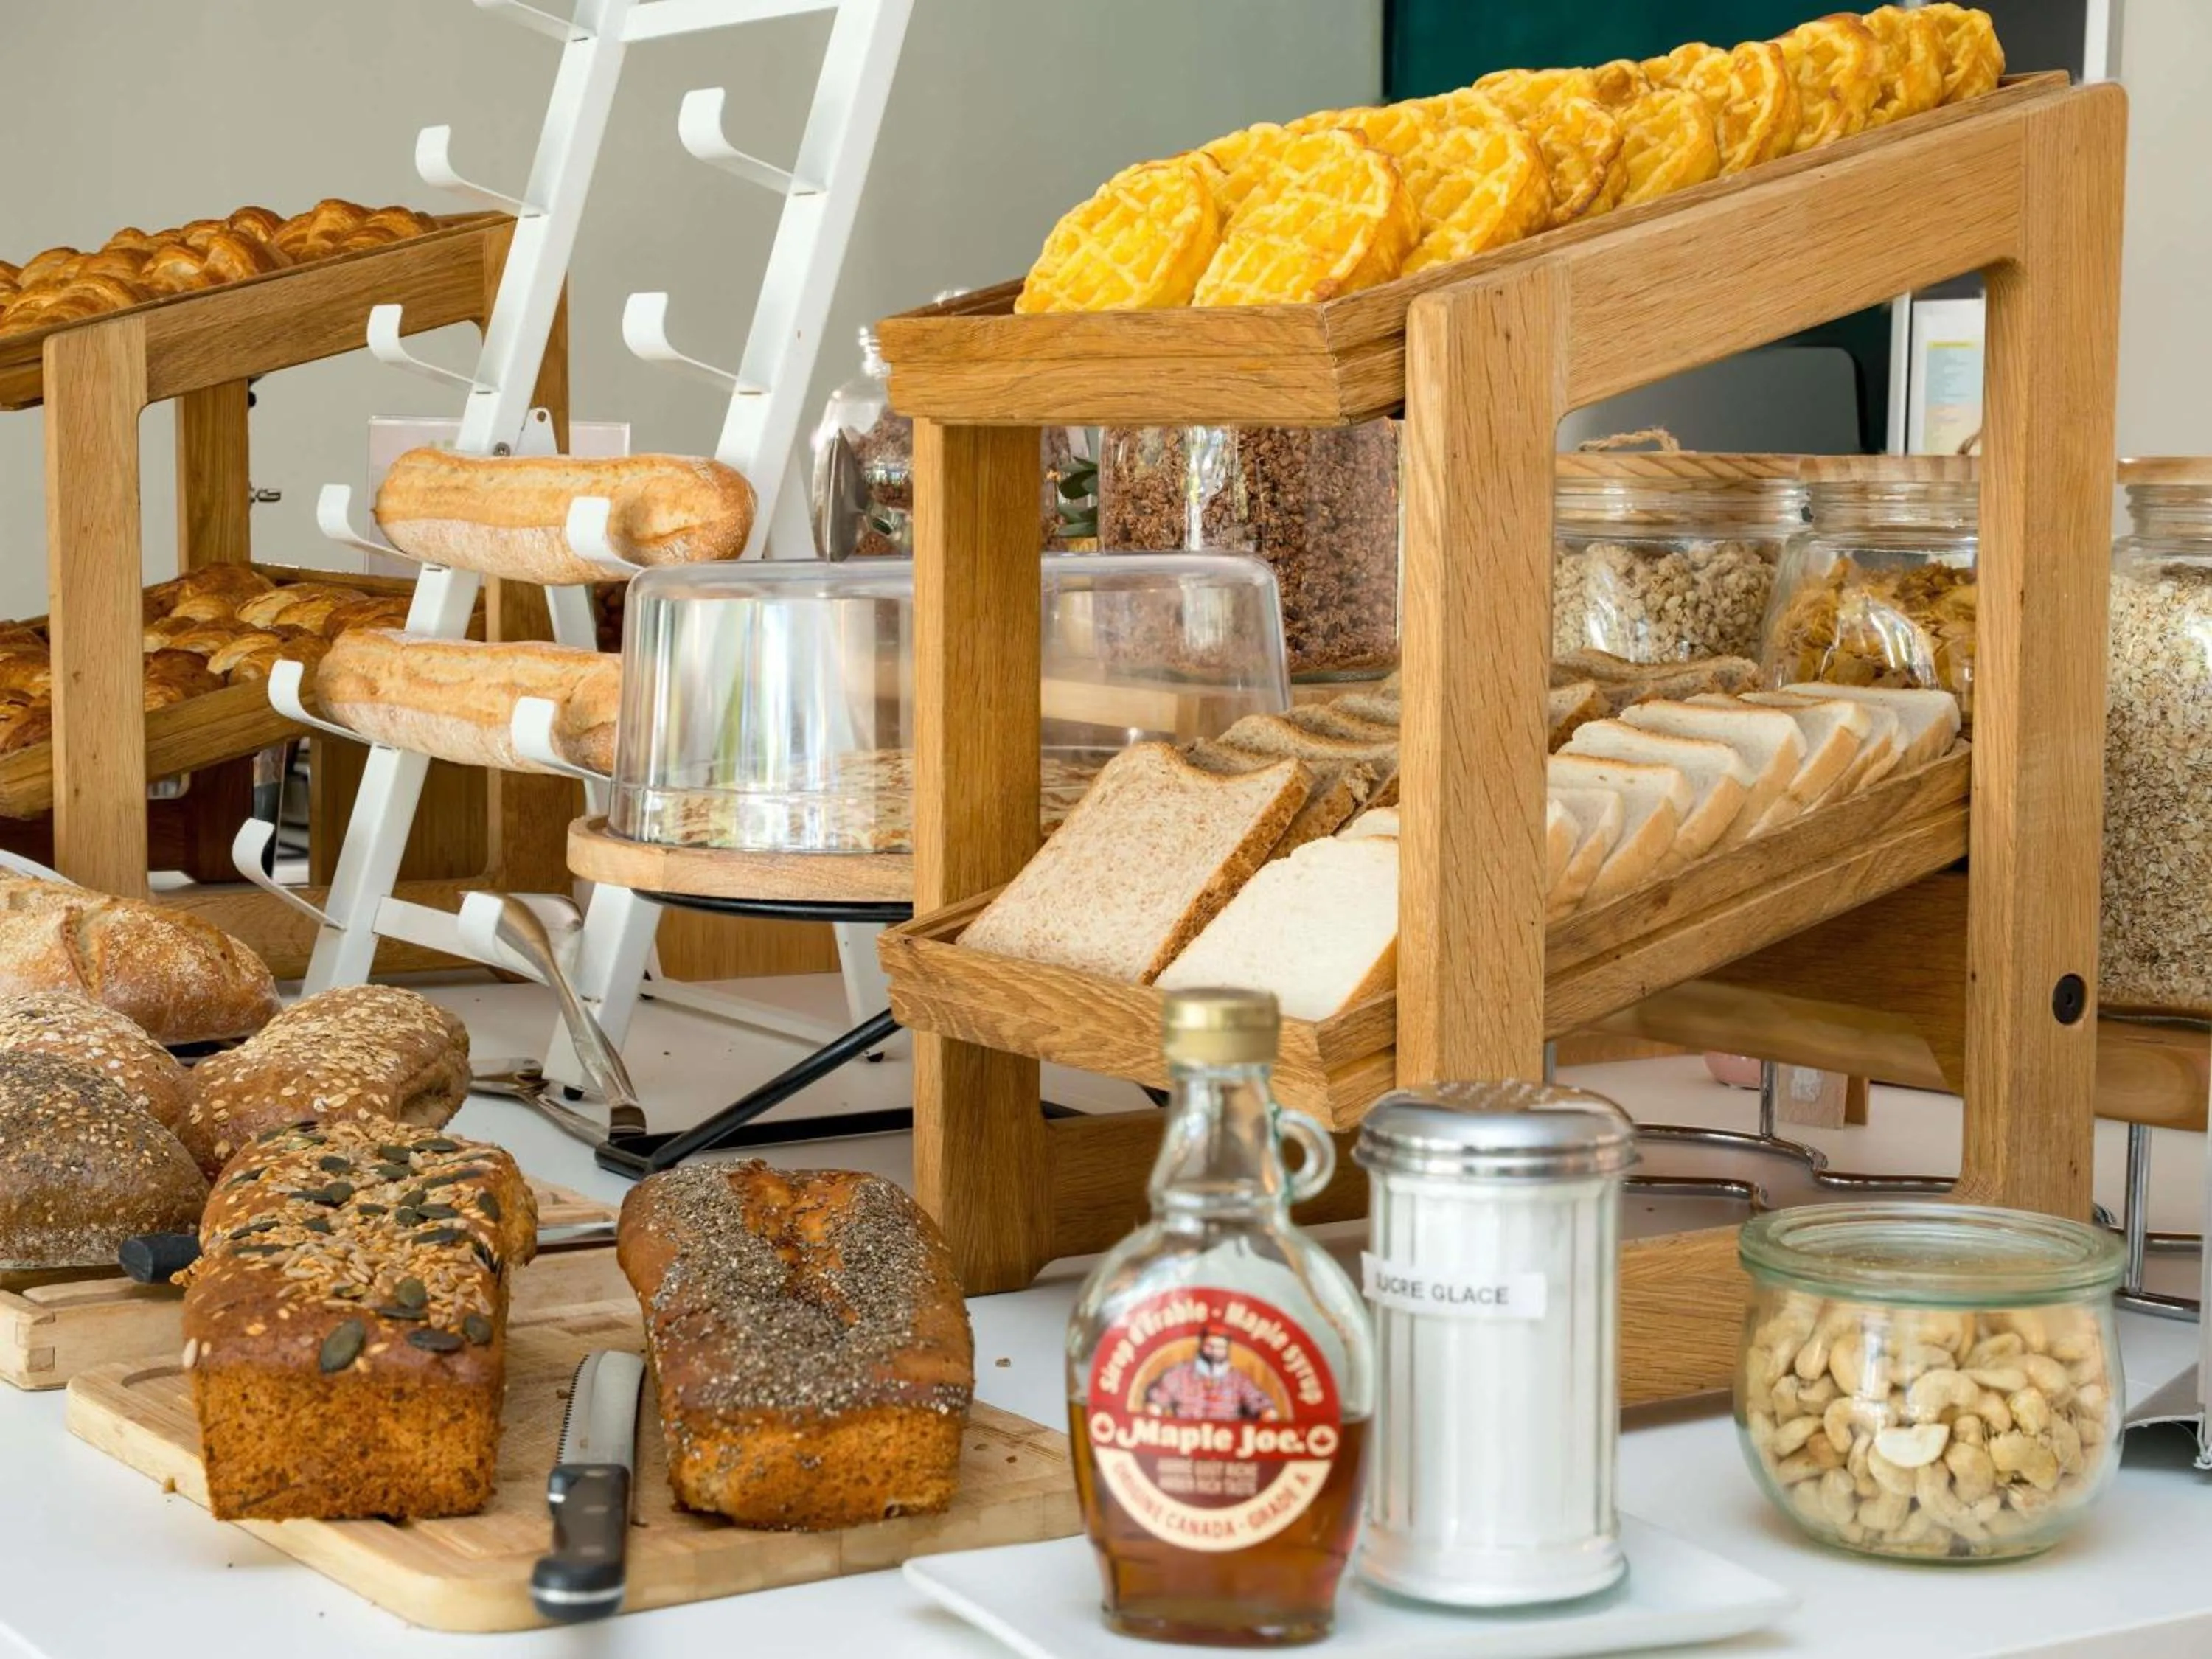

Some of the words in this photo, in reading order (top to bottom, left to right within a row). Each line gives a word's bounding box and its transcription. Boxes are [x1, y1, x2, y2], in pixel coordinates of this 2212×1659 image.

[1431, 1284, 1509, 1304] GLACE
[1224, 1301, 1289, 1350] Maple
[1116, 1417, 1234, 1455] Maple
[1166, 1512, 1237, 1539] CANADA
